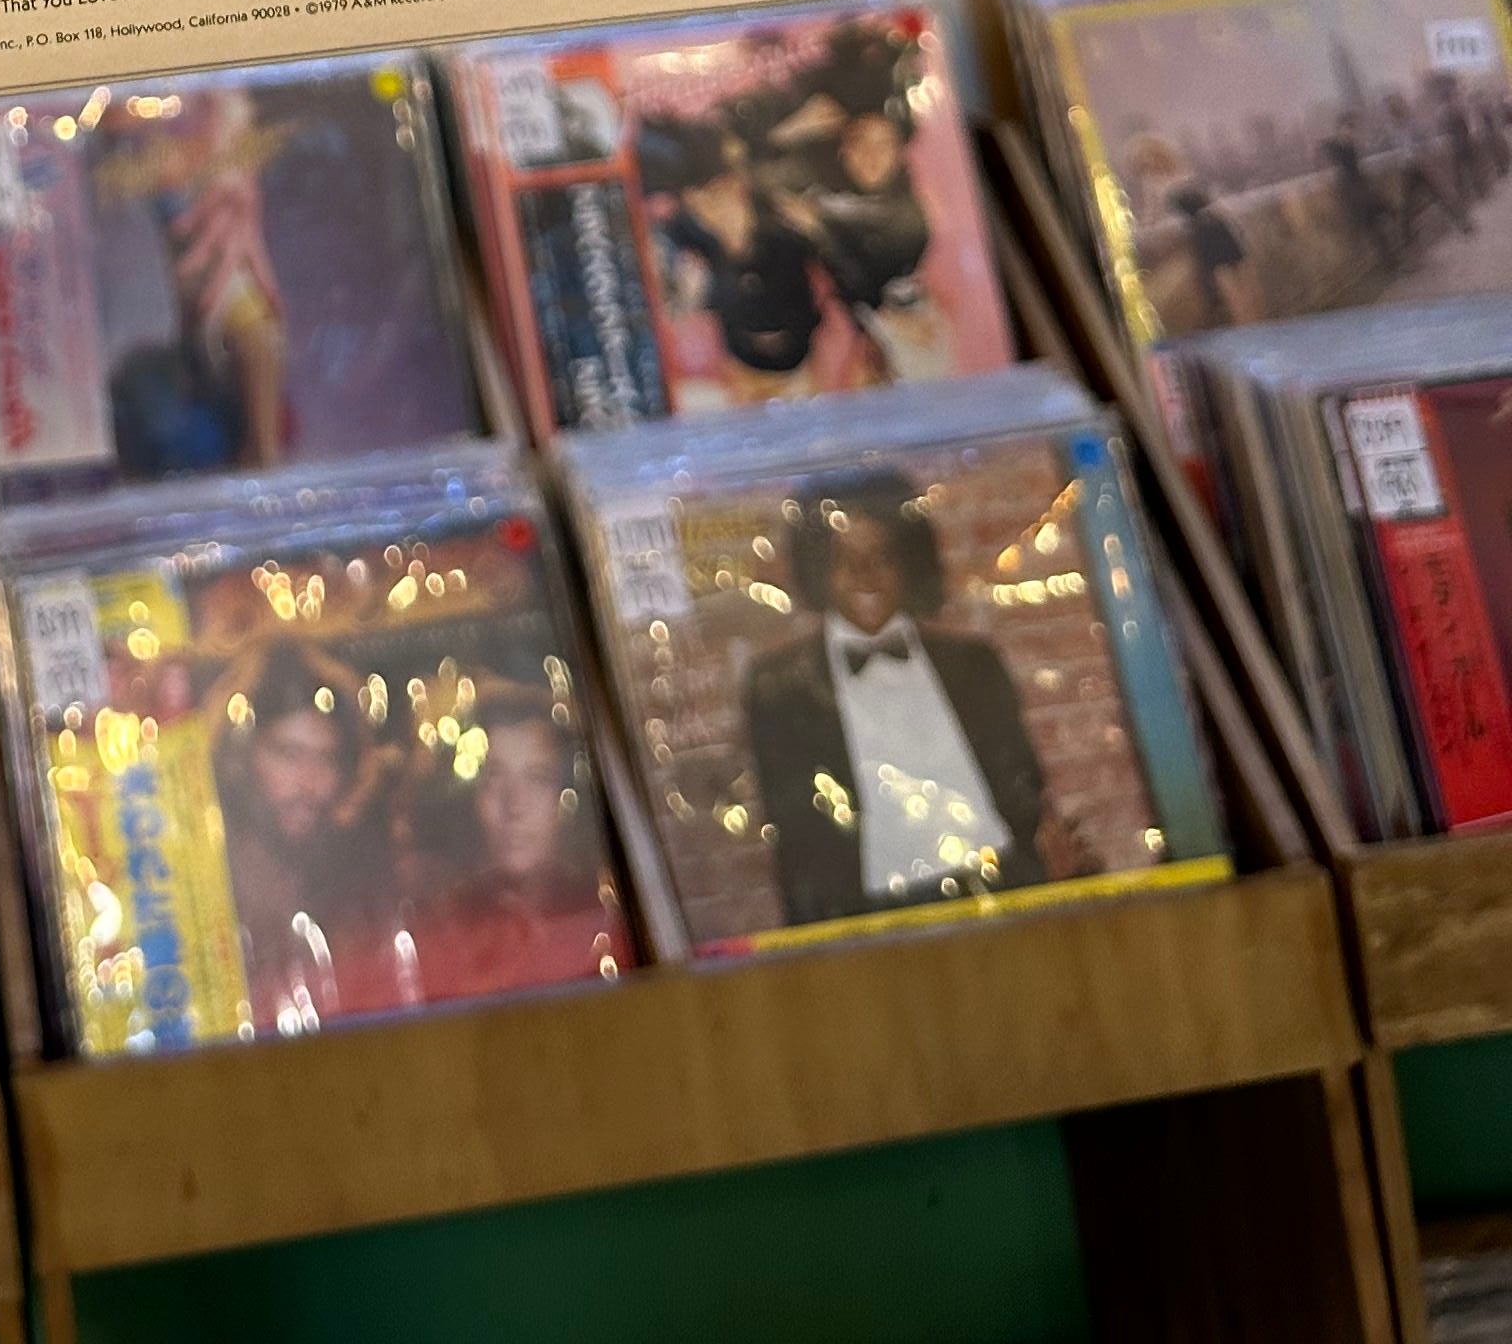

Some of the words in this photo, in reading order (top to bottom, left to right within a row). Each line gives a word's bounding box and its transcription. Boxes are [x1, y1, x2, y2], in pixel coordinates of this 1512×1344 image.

[25, 33, 52, 48] P.O.
[55, 31, 80, 44] Box
[84, 26, 107, 40] 118,
[110, 18, 185, 37] Hollywood,
[188, 12, 248, 28] California
[251, 4, 291, 21] 90028
